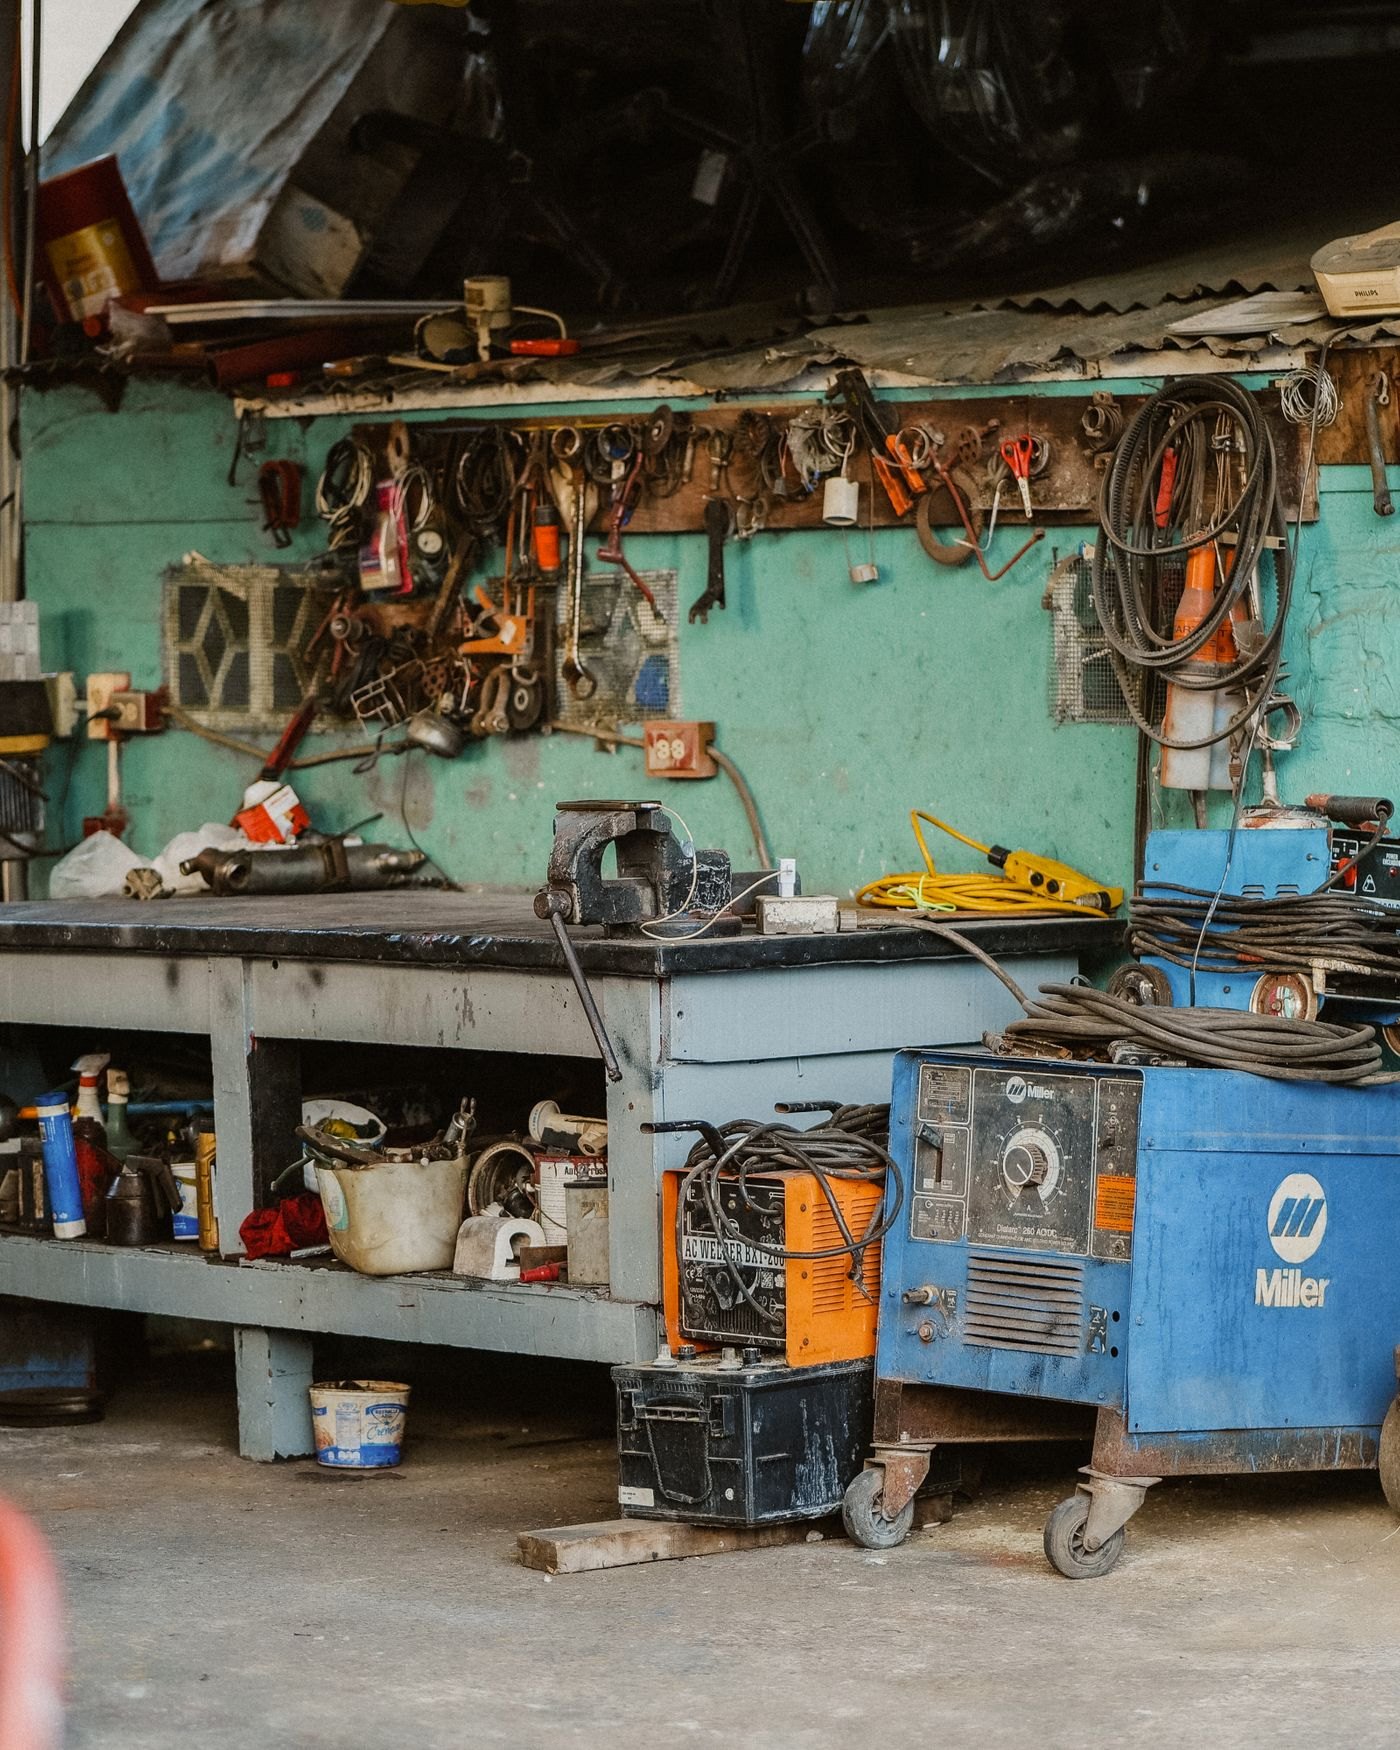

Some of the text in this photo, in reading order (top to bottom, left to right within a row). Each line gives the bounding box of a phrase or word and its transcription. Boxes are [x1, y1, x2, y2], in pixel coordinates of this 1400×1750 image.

[1354, 289, 1378, 297] PHILIPS
[1027, 1084, 1055, 1099] Miller
[685, 1238, 698, 1258] AC
[699, 1240, 743, 1262] WELDER
[1255, 1268, 1330, 1308] Miller
